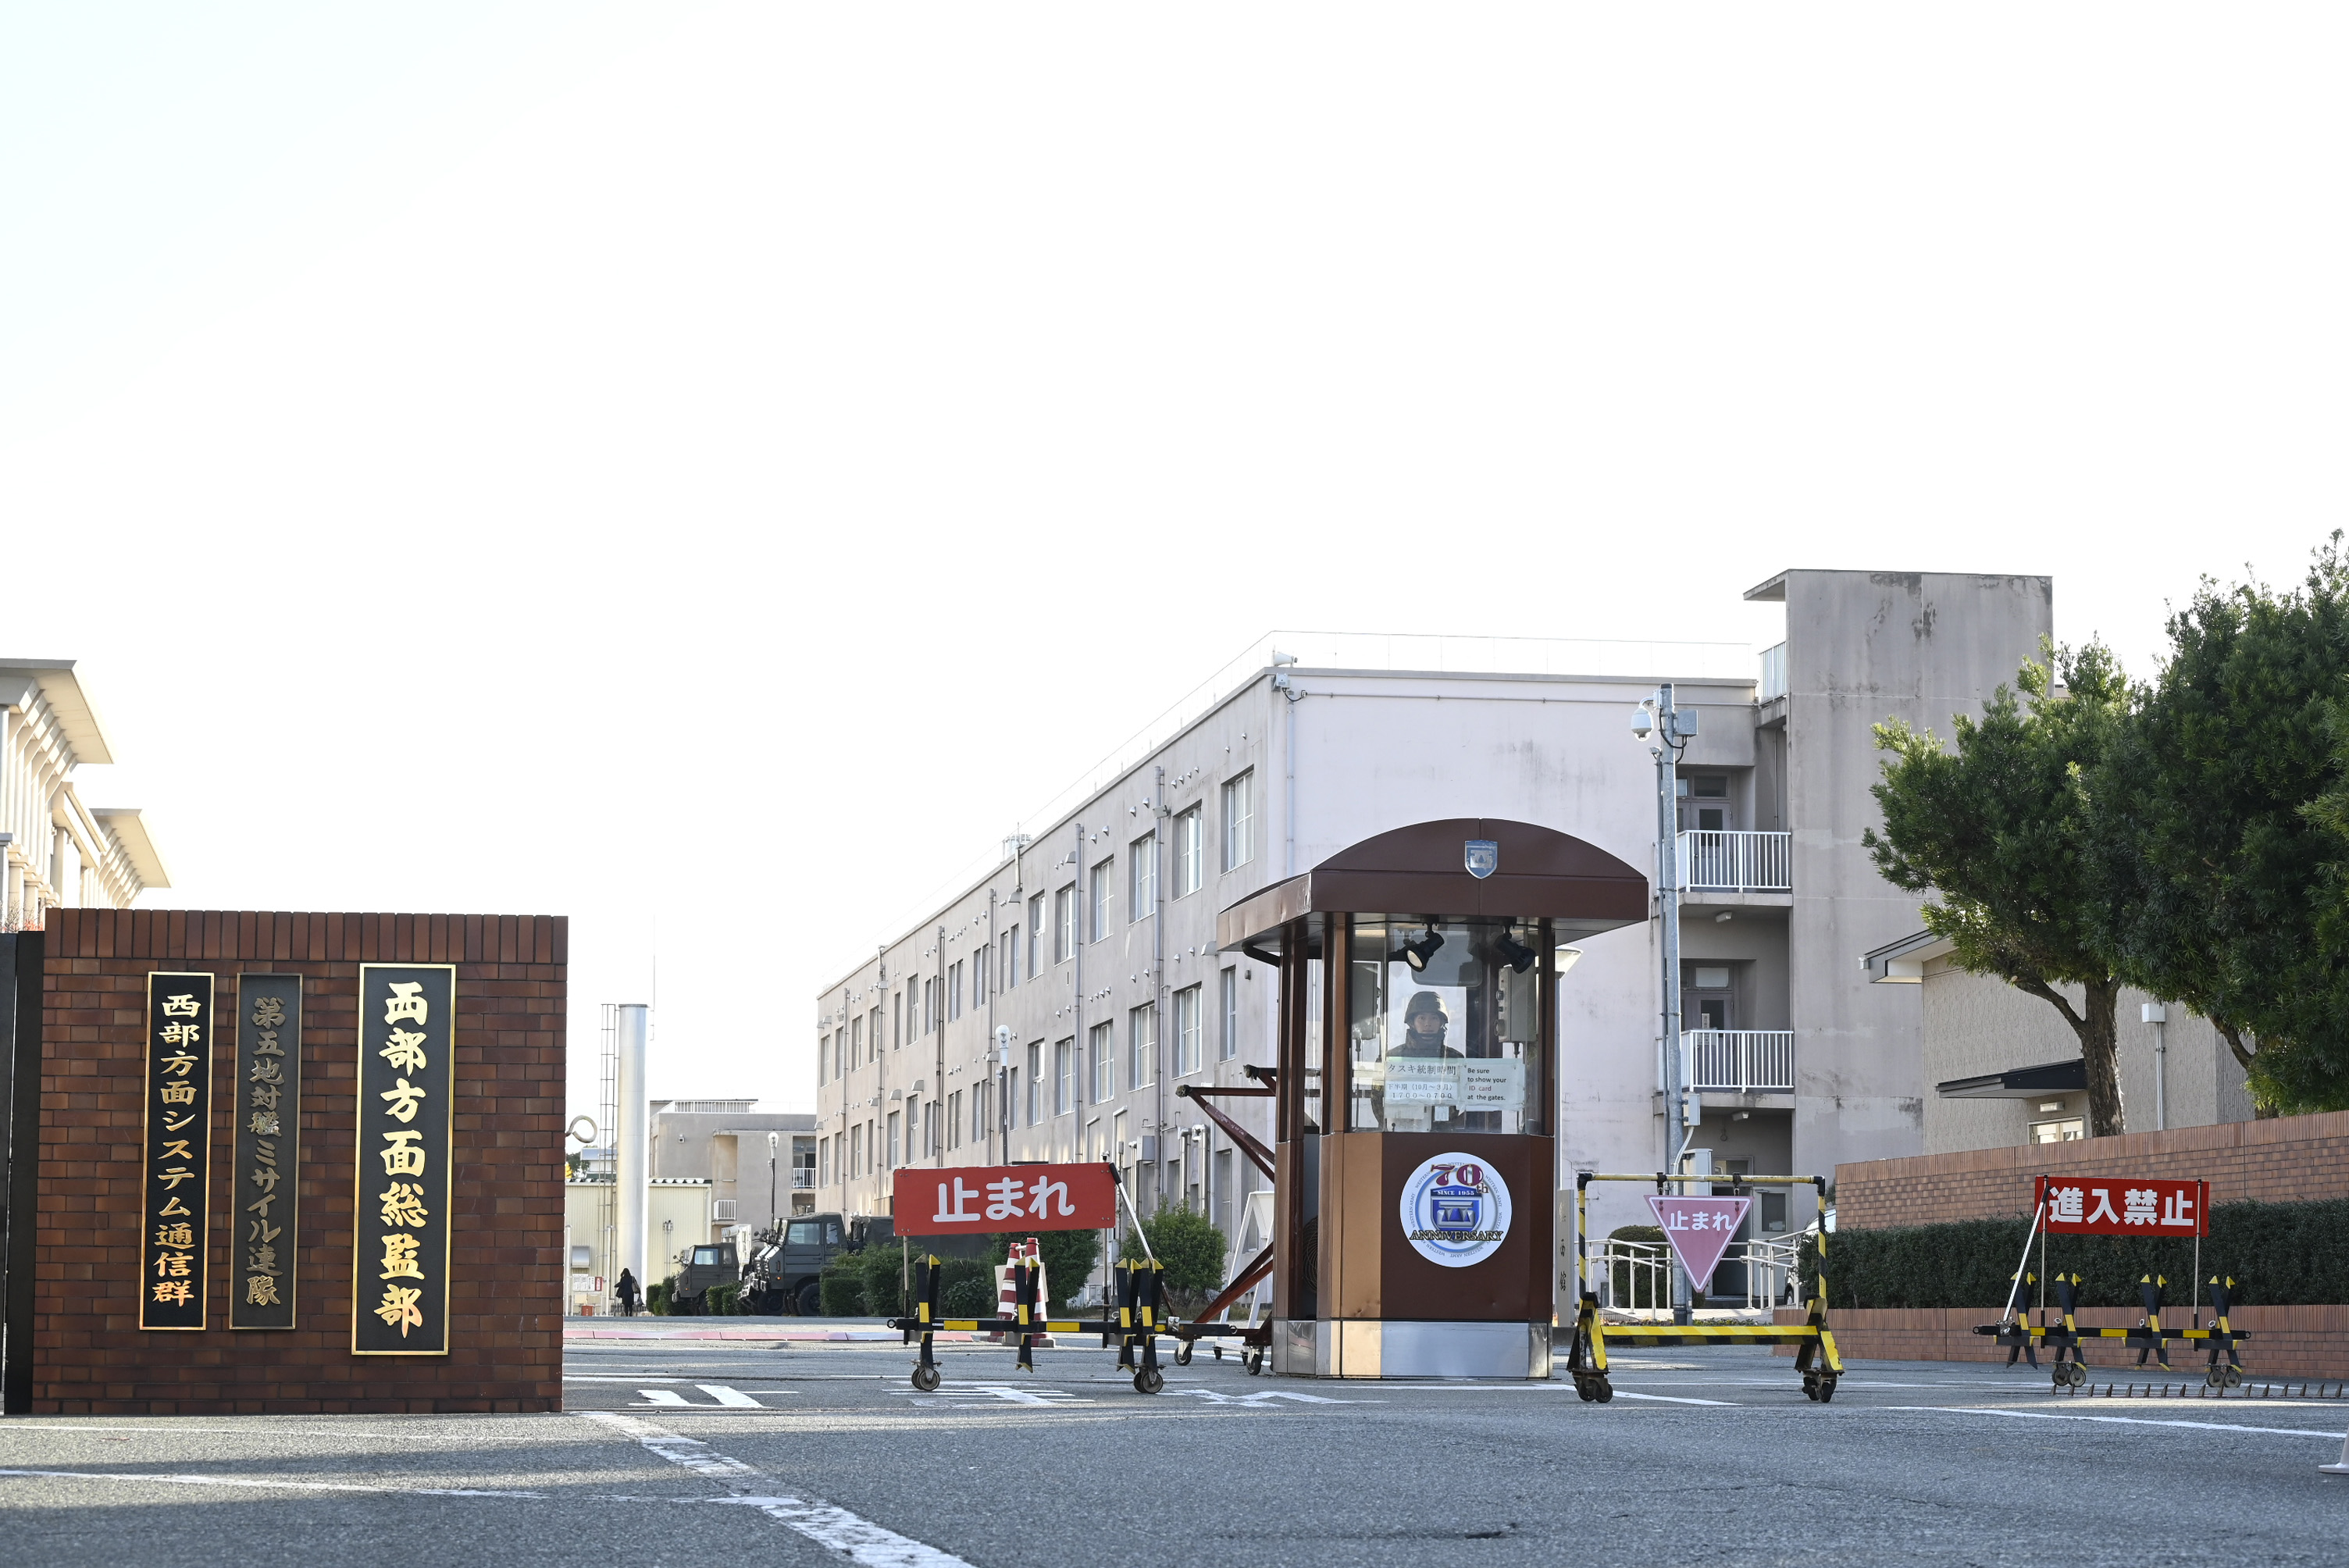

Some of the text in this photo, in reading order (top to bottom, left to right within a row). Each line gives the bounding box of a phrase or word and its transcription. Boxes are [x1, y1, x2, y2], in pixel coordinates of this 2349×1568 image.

[151, 993, 201, 1307] 西部方面システム通信群
[245, 996, 286, 1306] 第五地対艦ミサイル連隊
[373, 981, 428, 1338] 西部方面総監部
[932, 1175, 1075, 1222] 止まれ
[1668, 1210, 1733, 1231] 止まれ
[2048, 1186, 2194, 1226] 進入禁止
[1409, 1230, 1504, 1241] ANNIVERSARY
